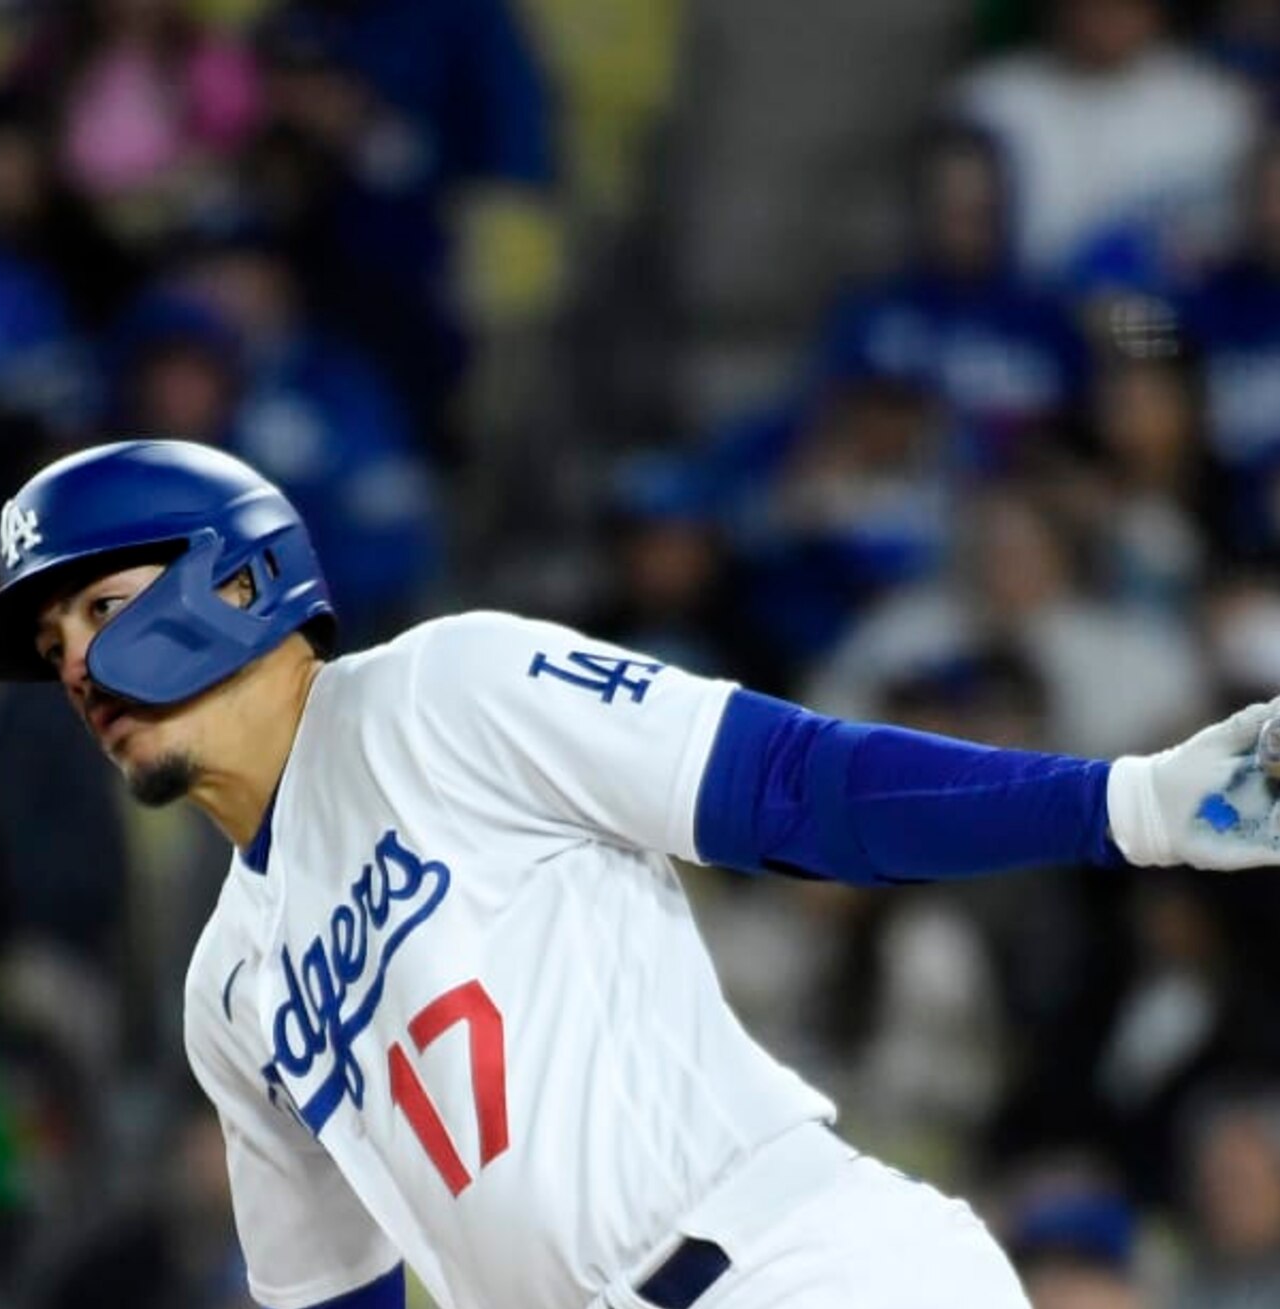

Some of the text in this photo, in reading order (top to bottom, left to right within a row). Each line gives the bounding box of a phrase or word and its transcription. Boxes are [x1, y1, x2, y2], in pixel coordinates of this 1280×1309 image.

[1, 499, 42, 569] LA
[526, 650, 664, 704] LA
[388, 978, 510, 1200] 17
